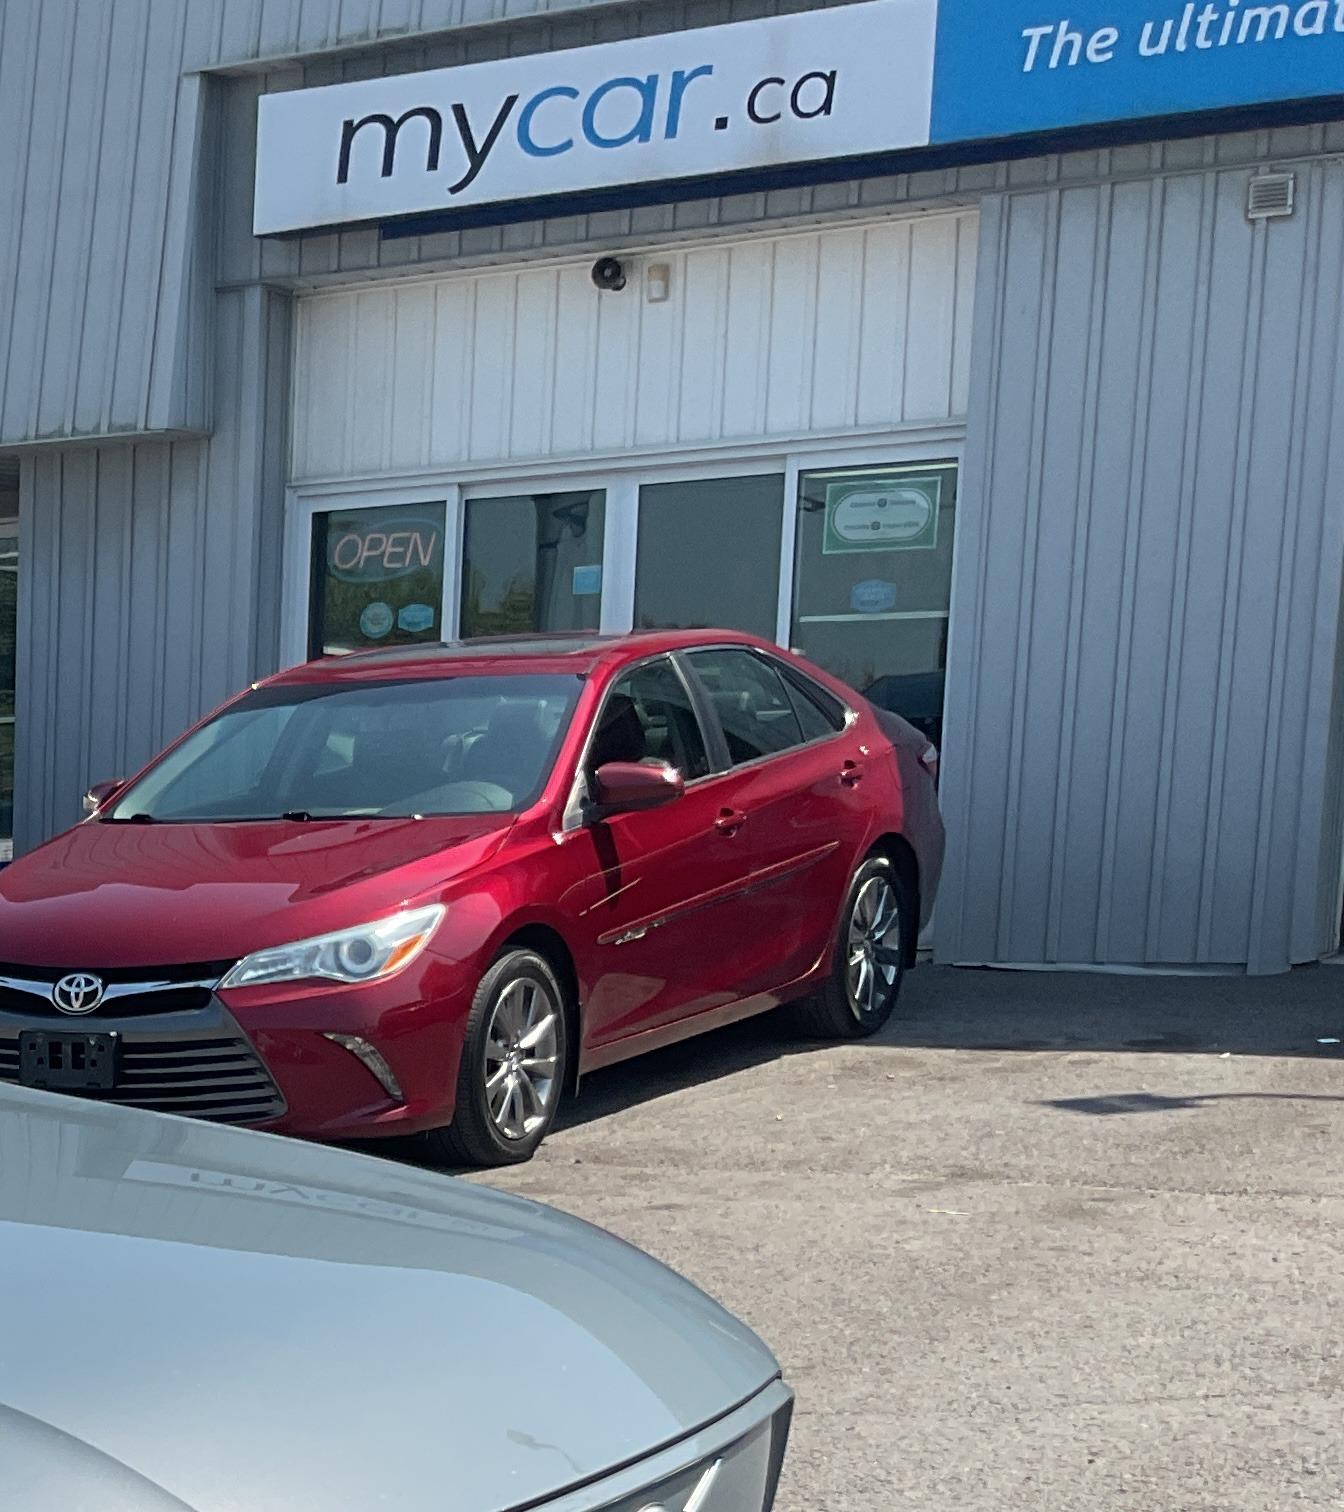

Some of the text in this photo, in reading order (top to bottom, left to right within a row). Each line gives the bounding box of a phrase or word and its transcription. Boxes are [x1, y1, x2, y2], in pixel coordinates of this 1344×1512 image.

[1021, 20, 1119, 73] The
[336, 64, 838, 196] mycar.ca
[334, 531, 436, 570] OPEN
